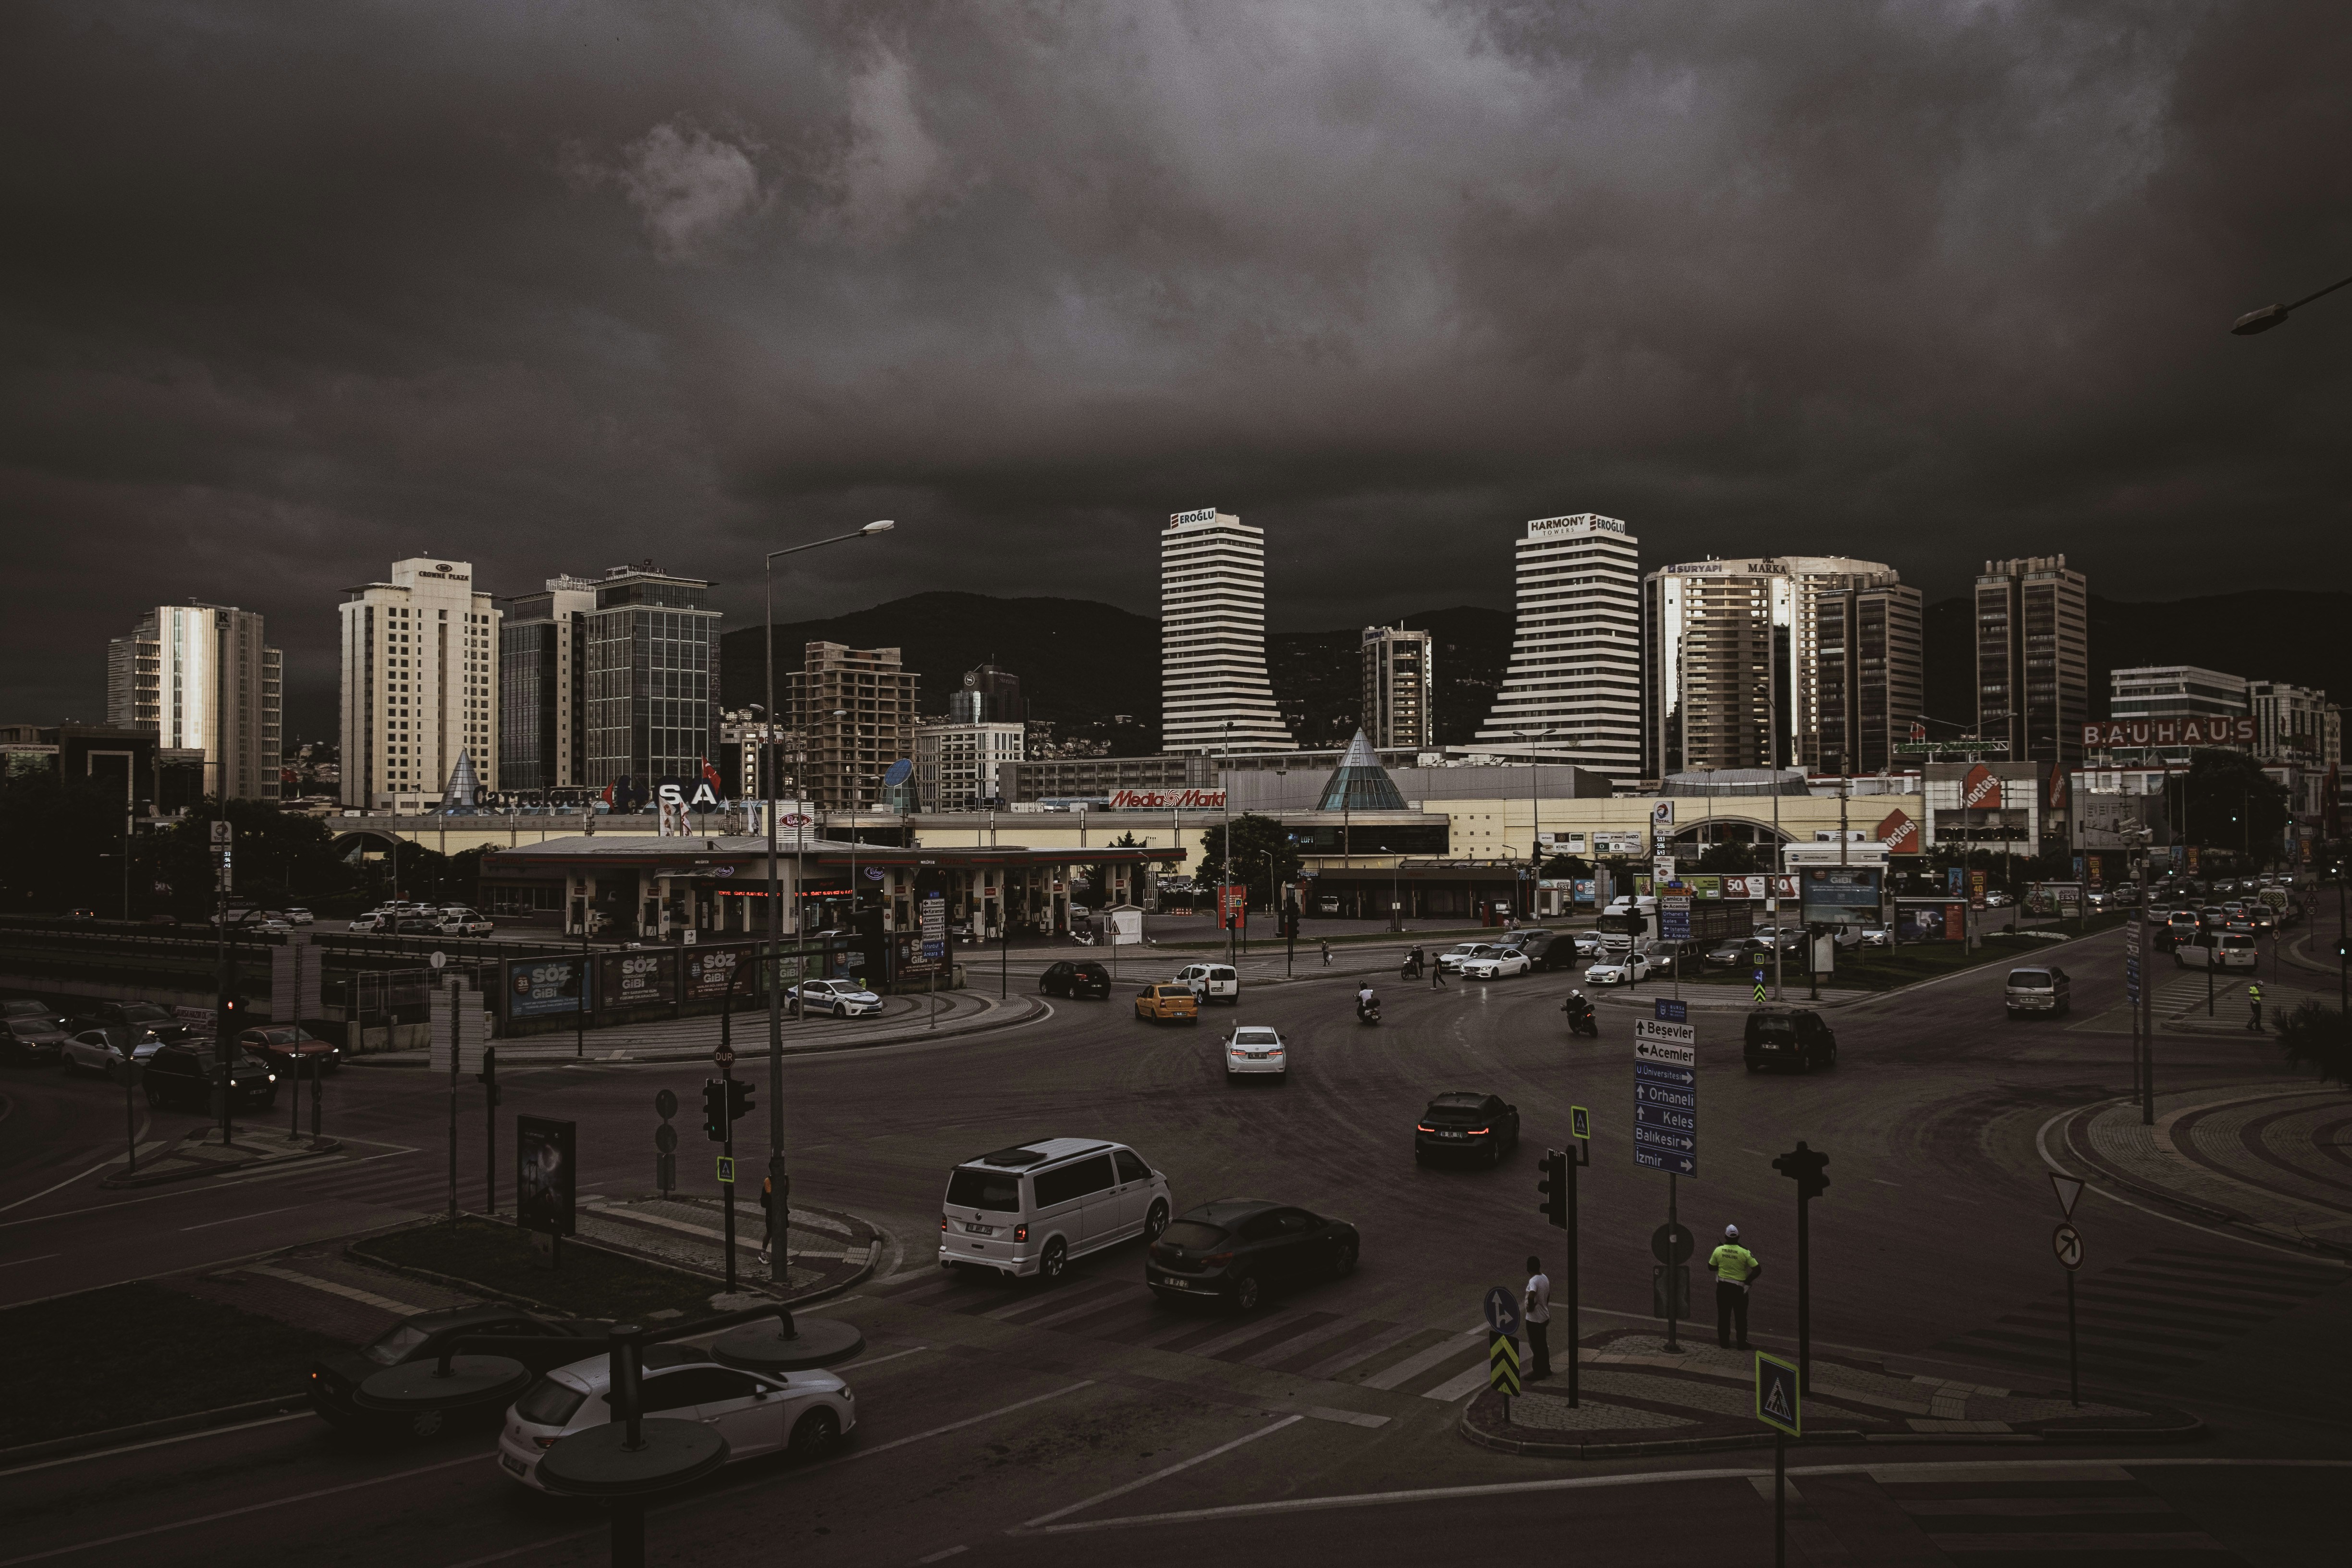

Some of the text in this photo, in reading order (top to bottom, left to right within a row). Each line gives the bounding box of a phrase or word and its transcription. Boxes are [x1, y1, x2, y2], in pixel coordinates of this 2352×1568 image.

[1180, 510, 1214, 524] EROĞLU
[1531, 515, 1625, 533] HARMONY EROĞLU
[1543, 527, 1574, 536] TOWERS
[1748, 564, 1787, 574] MARKA
[218, 611, 229, 623] R
[2084, 720, 2254, 745] BAUHAUS
[473, 784, 596, 808] Carrefour
[1110, 789, 1226, 807] Media Markt
[1727, 879, 1743, 890] 50
[622, 955, 657, 974] SÖZ
[704, 950, 736, 968] SÖZ
[532, 963, 573, 983] SÖZ
[1648, 1022, 1693, 1039] Beşevler
[716, 1052, 733, 1061] DUR
[1650, 1045, 1693, 1062] Acemler
[1637, 1066, 1681, 1080] U.Üniversitesi
[1650, 1087, 1693, 1106] Orhaneli
[1663, 1111, 1693, 1128] Keles
[1636, 1127, 1679, 1147] Balıkesir
[1636, 1147, 1662, 1167] İzmir
